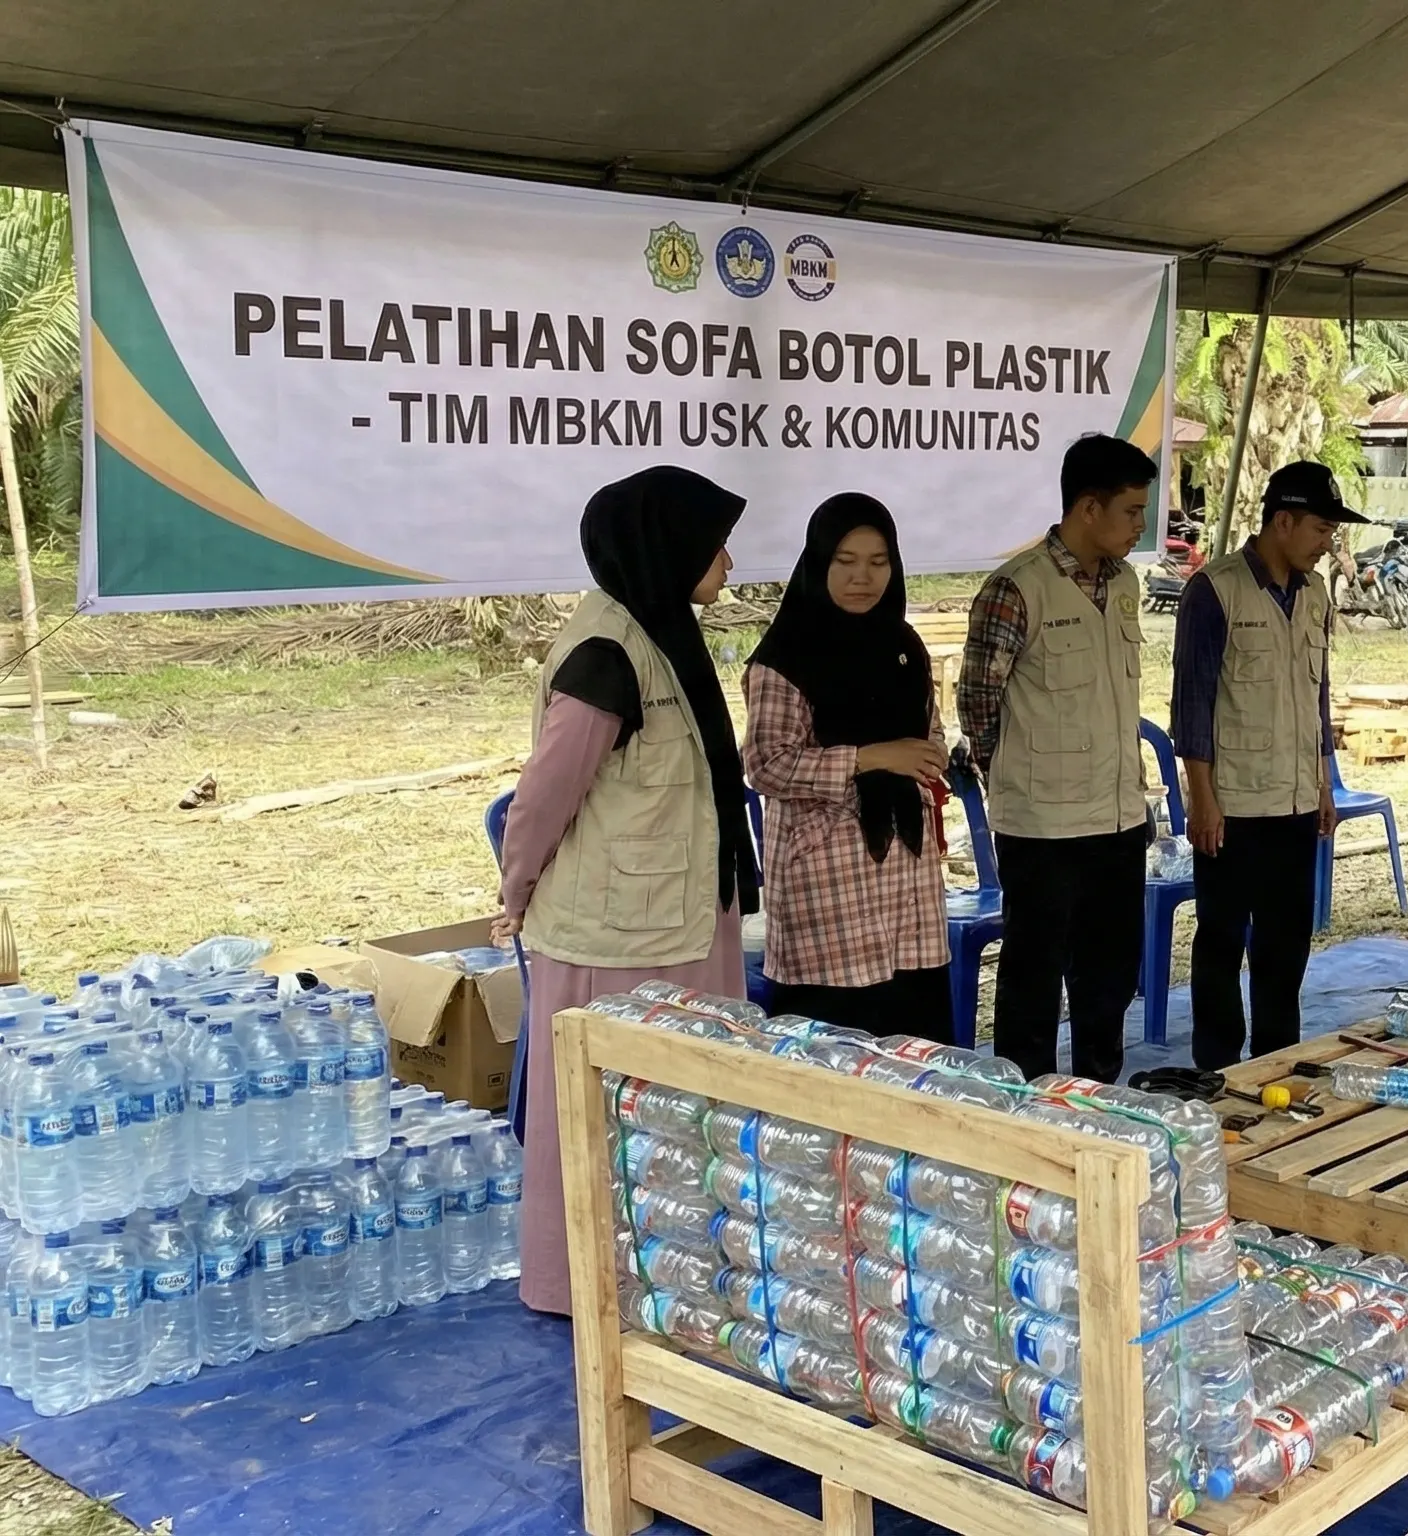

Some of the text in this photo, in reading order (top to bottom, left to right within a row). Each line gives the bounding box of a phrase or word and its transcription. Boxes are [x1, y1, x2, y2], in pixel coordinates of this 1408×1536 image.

[790, 258, 828, 278] MBKM
[232, 291, 1112, 396] PELATIHAN SOFA BOTOL PLASTIK
[388, 391, 488, 445] TIM
[509, 396, 663, 448] MBKM
[678, 401, 770, 449] USK
[780, 404, 813, 450] &
[825, 406, 1041, 452] KOMUNITAS
